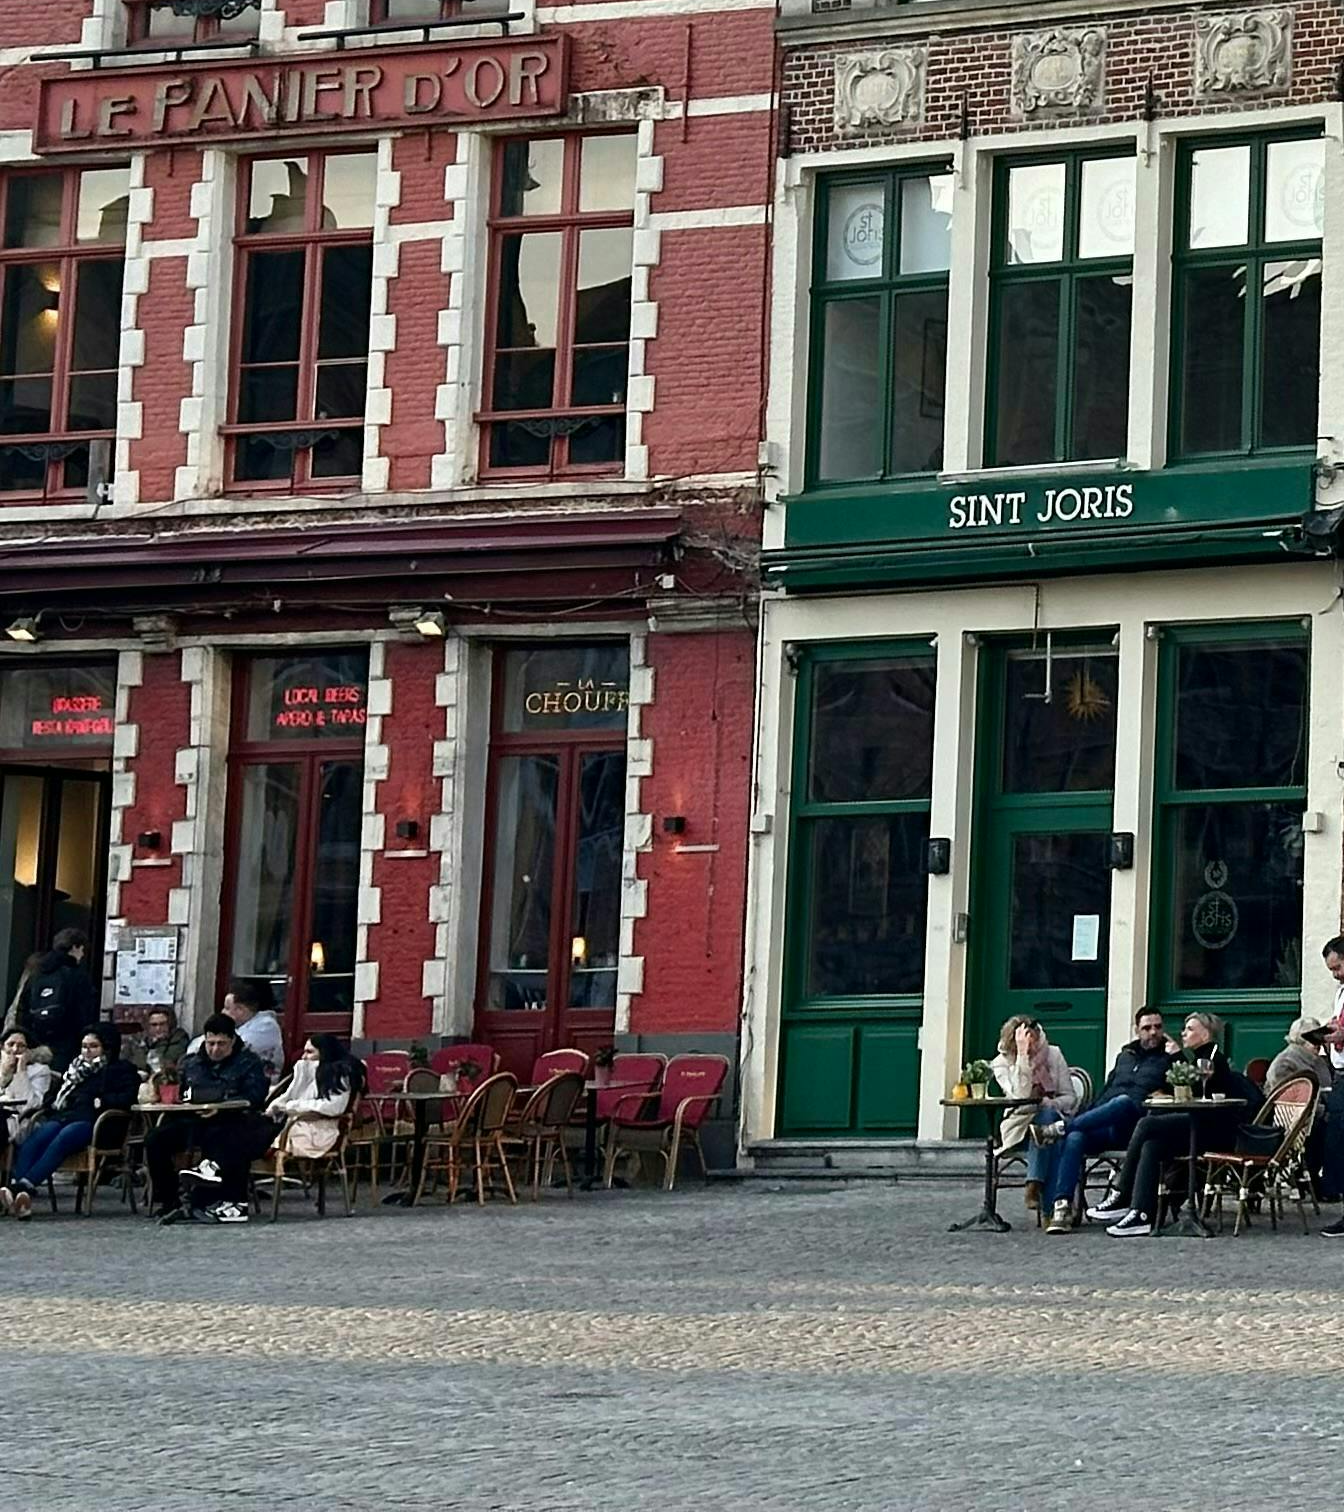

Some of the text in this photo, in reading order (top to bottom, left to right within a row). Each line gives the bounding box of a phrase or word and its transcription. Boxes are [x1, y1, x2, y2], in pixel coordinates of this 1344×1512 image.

[60, 50, 550, 141] LE PANIER D'OR
[949, 484, 1134, 529] SINT JORIS
[579, 678, 595, 690] LA
